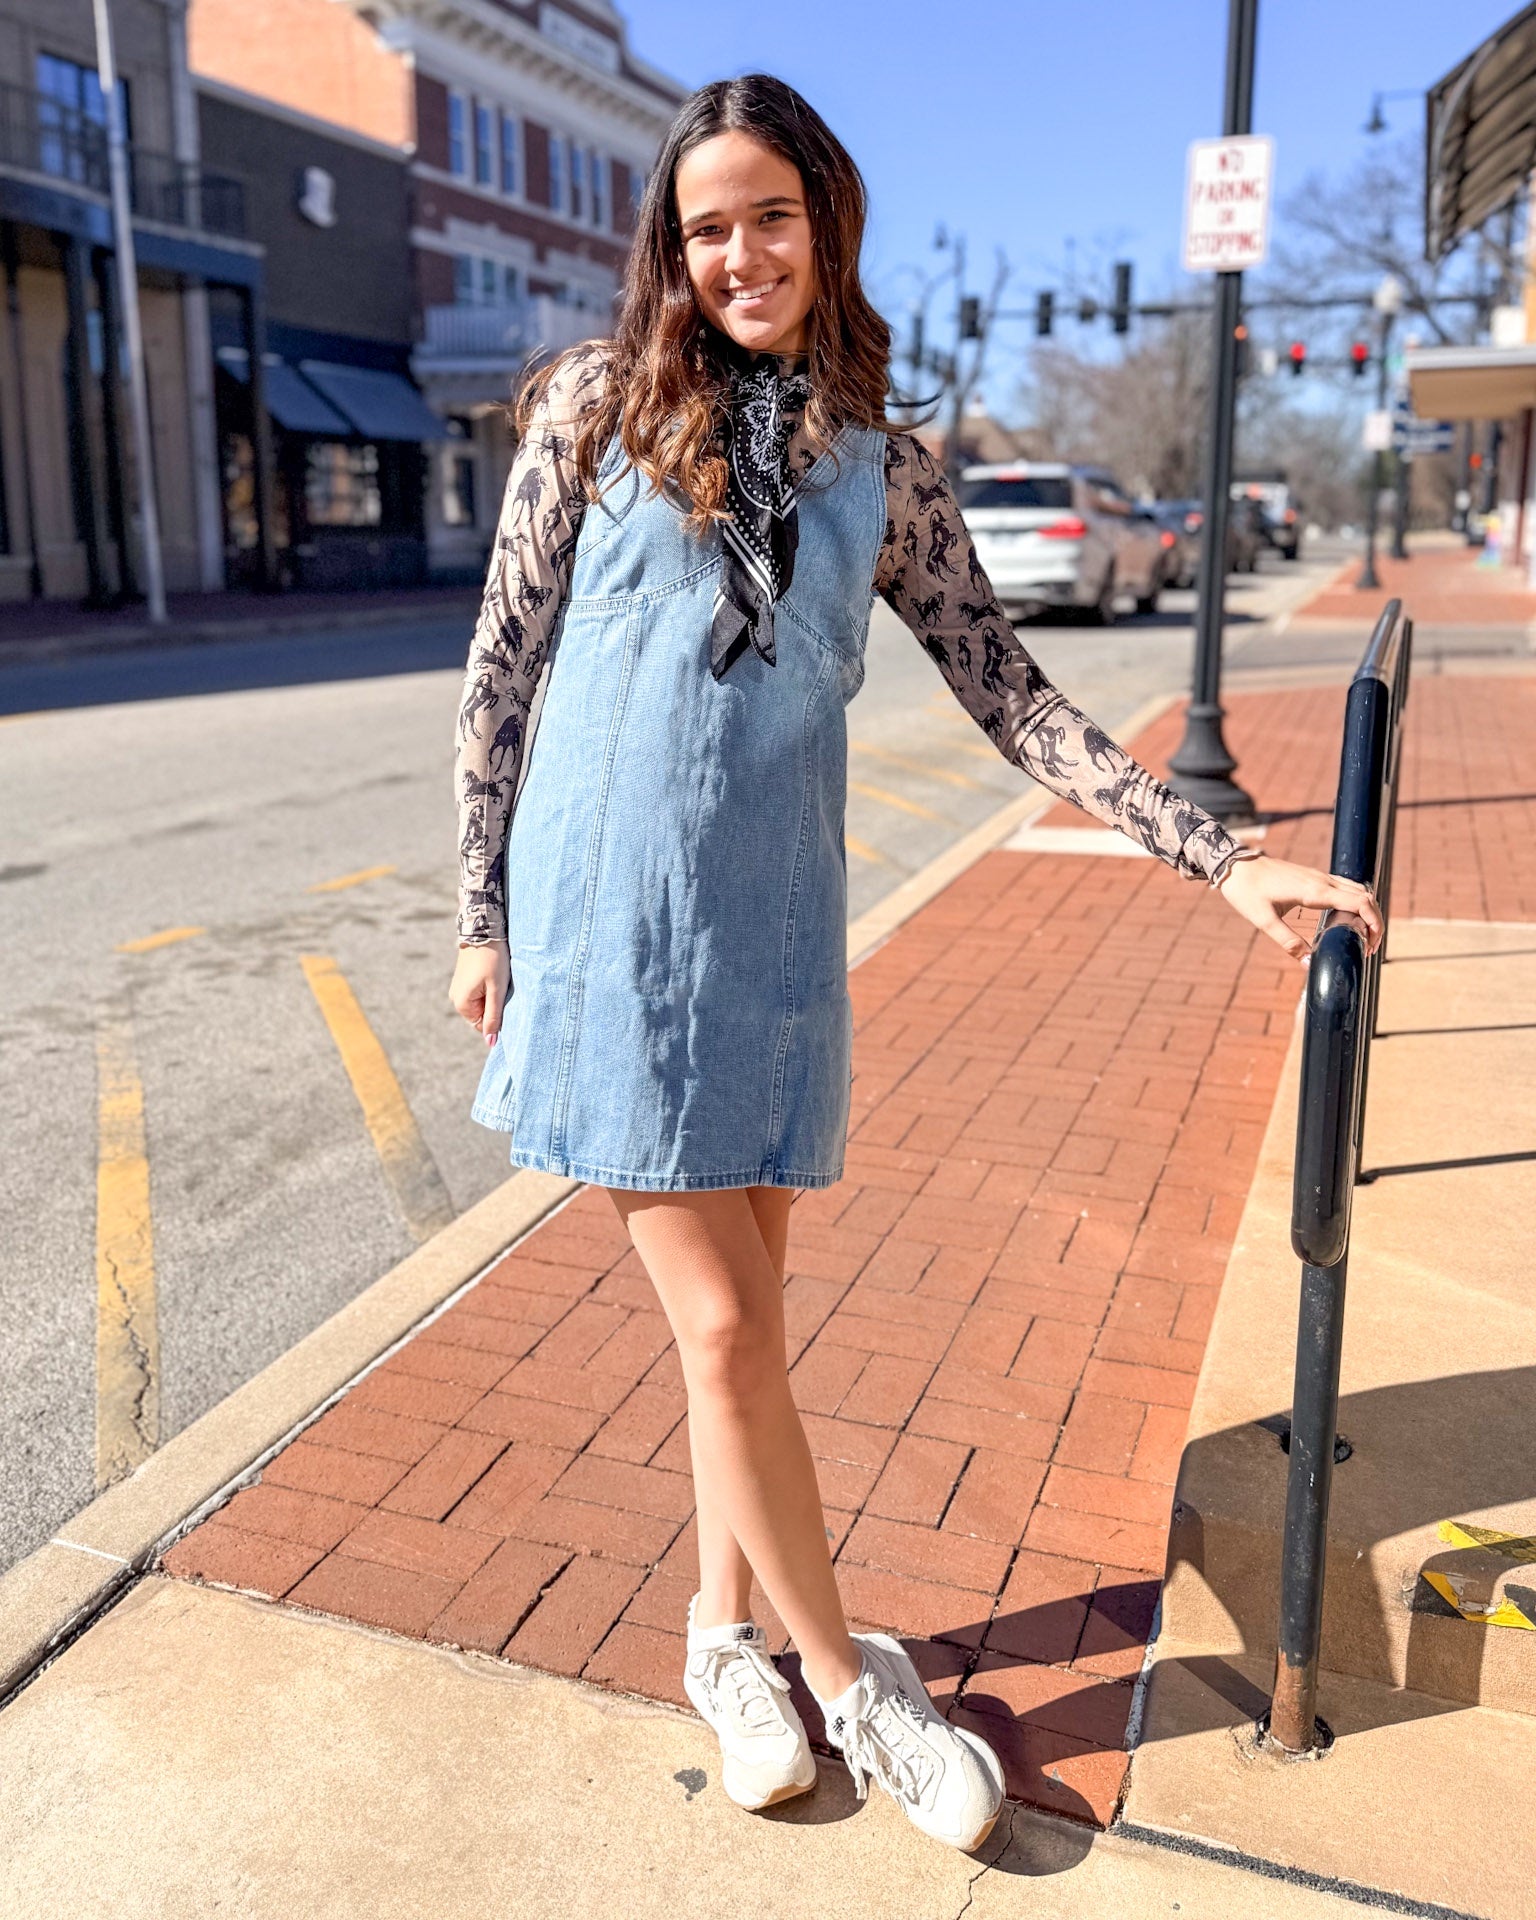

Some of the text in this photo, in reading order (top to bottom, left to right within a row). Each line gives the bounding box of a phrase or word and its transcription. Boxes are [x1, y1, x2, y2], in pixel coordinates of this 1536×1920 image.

[1217, 149, 1245, 173] NO
[1194, 177, 1264, 203] PARKING
[1188, 230, 1263, 256] STOPPING
